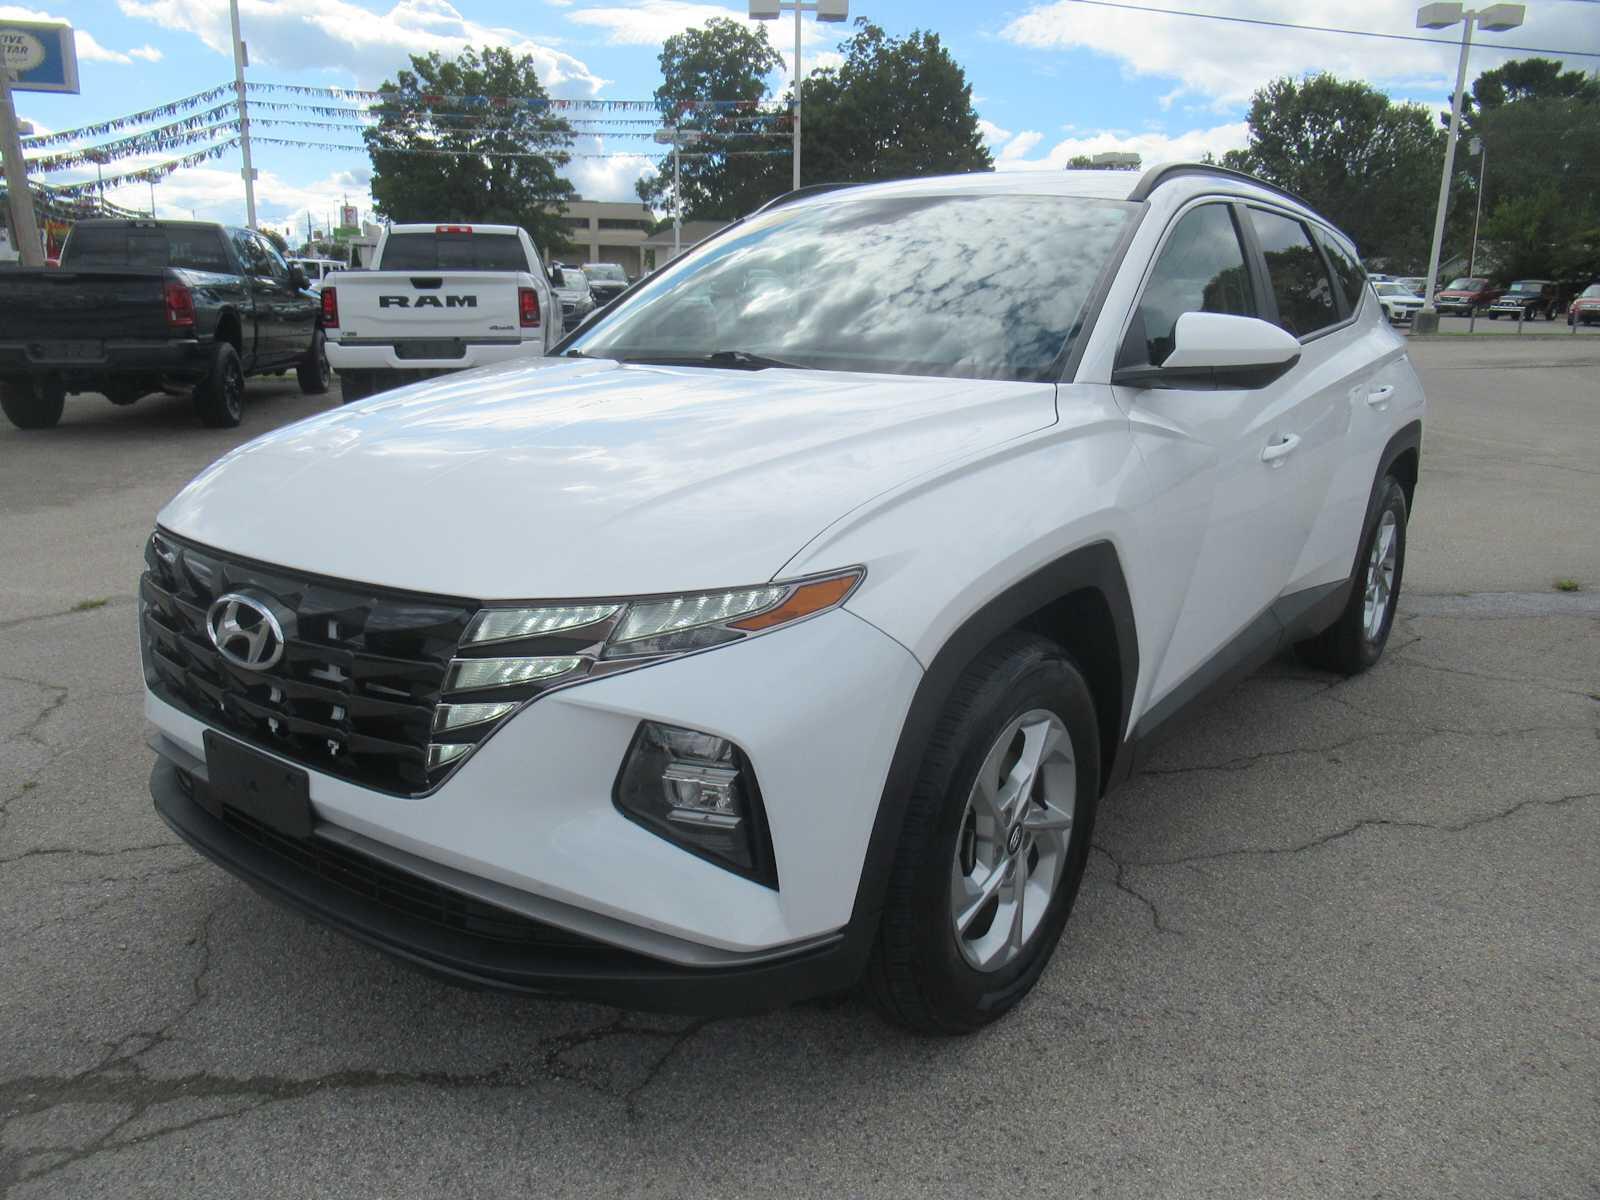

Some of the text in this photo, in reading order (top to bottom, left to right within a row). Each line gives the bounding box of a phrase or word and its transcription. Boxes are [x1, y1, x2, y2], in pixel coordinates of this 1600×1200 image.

[0, 35, 24, 44] IVE
[2, 45, 28, 54] TAR
[379, 295, 477, 308] RAM
